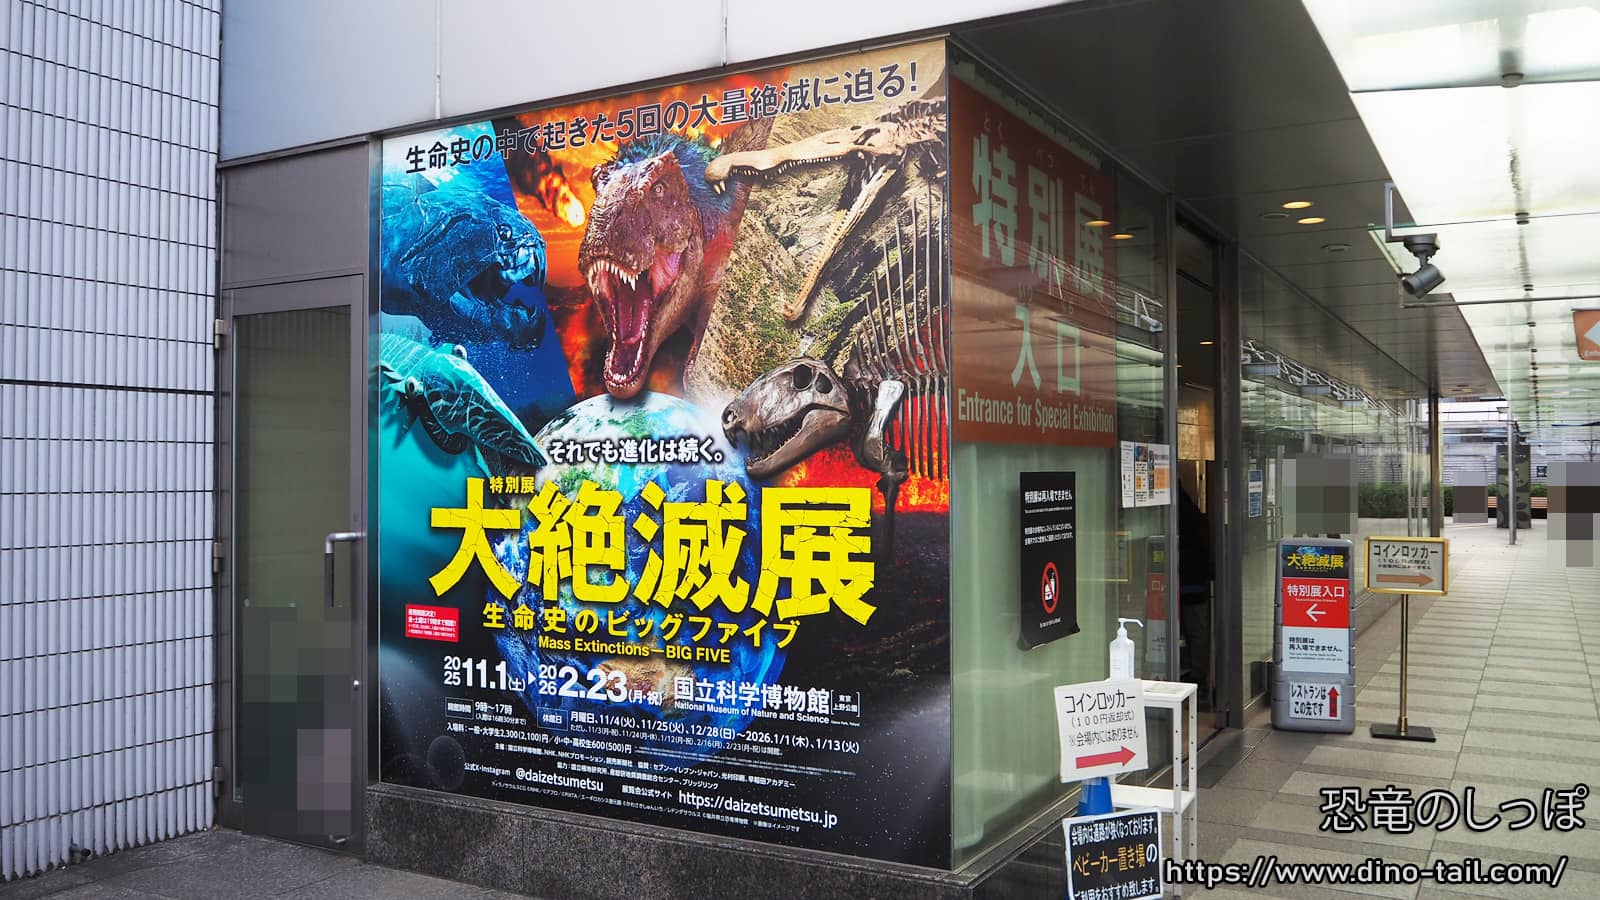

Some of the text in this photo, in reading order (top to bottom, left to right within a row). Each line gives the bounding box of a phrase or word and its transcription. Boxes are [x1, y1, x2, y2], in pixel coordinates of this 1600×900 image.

[972, 132, 1106, 300] 特別展
[1011, 304, 1081, 397] 入口
[958, 388, 1114, 434] Entrance for Special Exhibition
[549, 438, 724, 464] それでも進化は続く。
[489, 475, 535, 495] 特別展
[428, 477, 878, 625] 大絶滅展
[1373, 544, 1439, 559] コインロッカー
[1287, 584, 1345, 598] 特別展入口
[482, 602, 800, 649] 生命史のビッグファイブ
[538, 636, 571, 652] Mass
[696, 648, 731, 664] FIVE
[674, 676, 829, 714] 国立科学博物館
[1064, 688, 1136, 714] コインロッカー
[1291, 684, 1327, 700] レストランは
[674, 701, 706, 713] National
[707, 704, 740, 716] Museum
[741, 708, 749, 716] of
[751, 709, 778, 721] Nature
[779, 712, 795, 721] and
[796, 713, 830, 725] Science
[515, 768, 604, 792] @daizetsumetsu
[678, 789, 838, 829] https://daizetsumetsu.jp
[1072, 842, 1158, 876] ベビーカー置き場の
